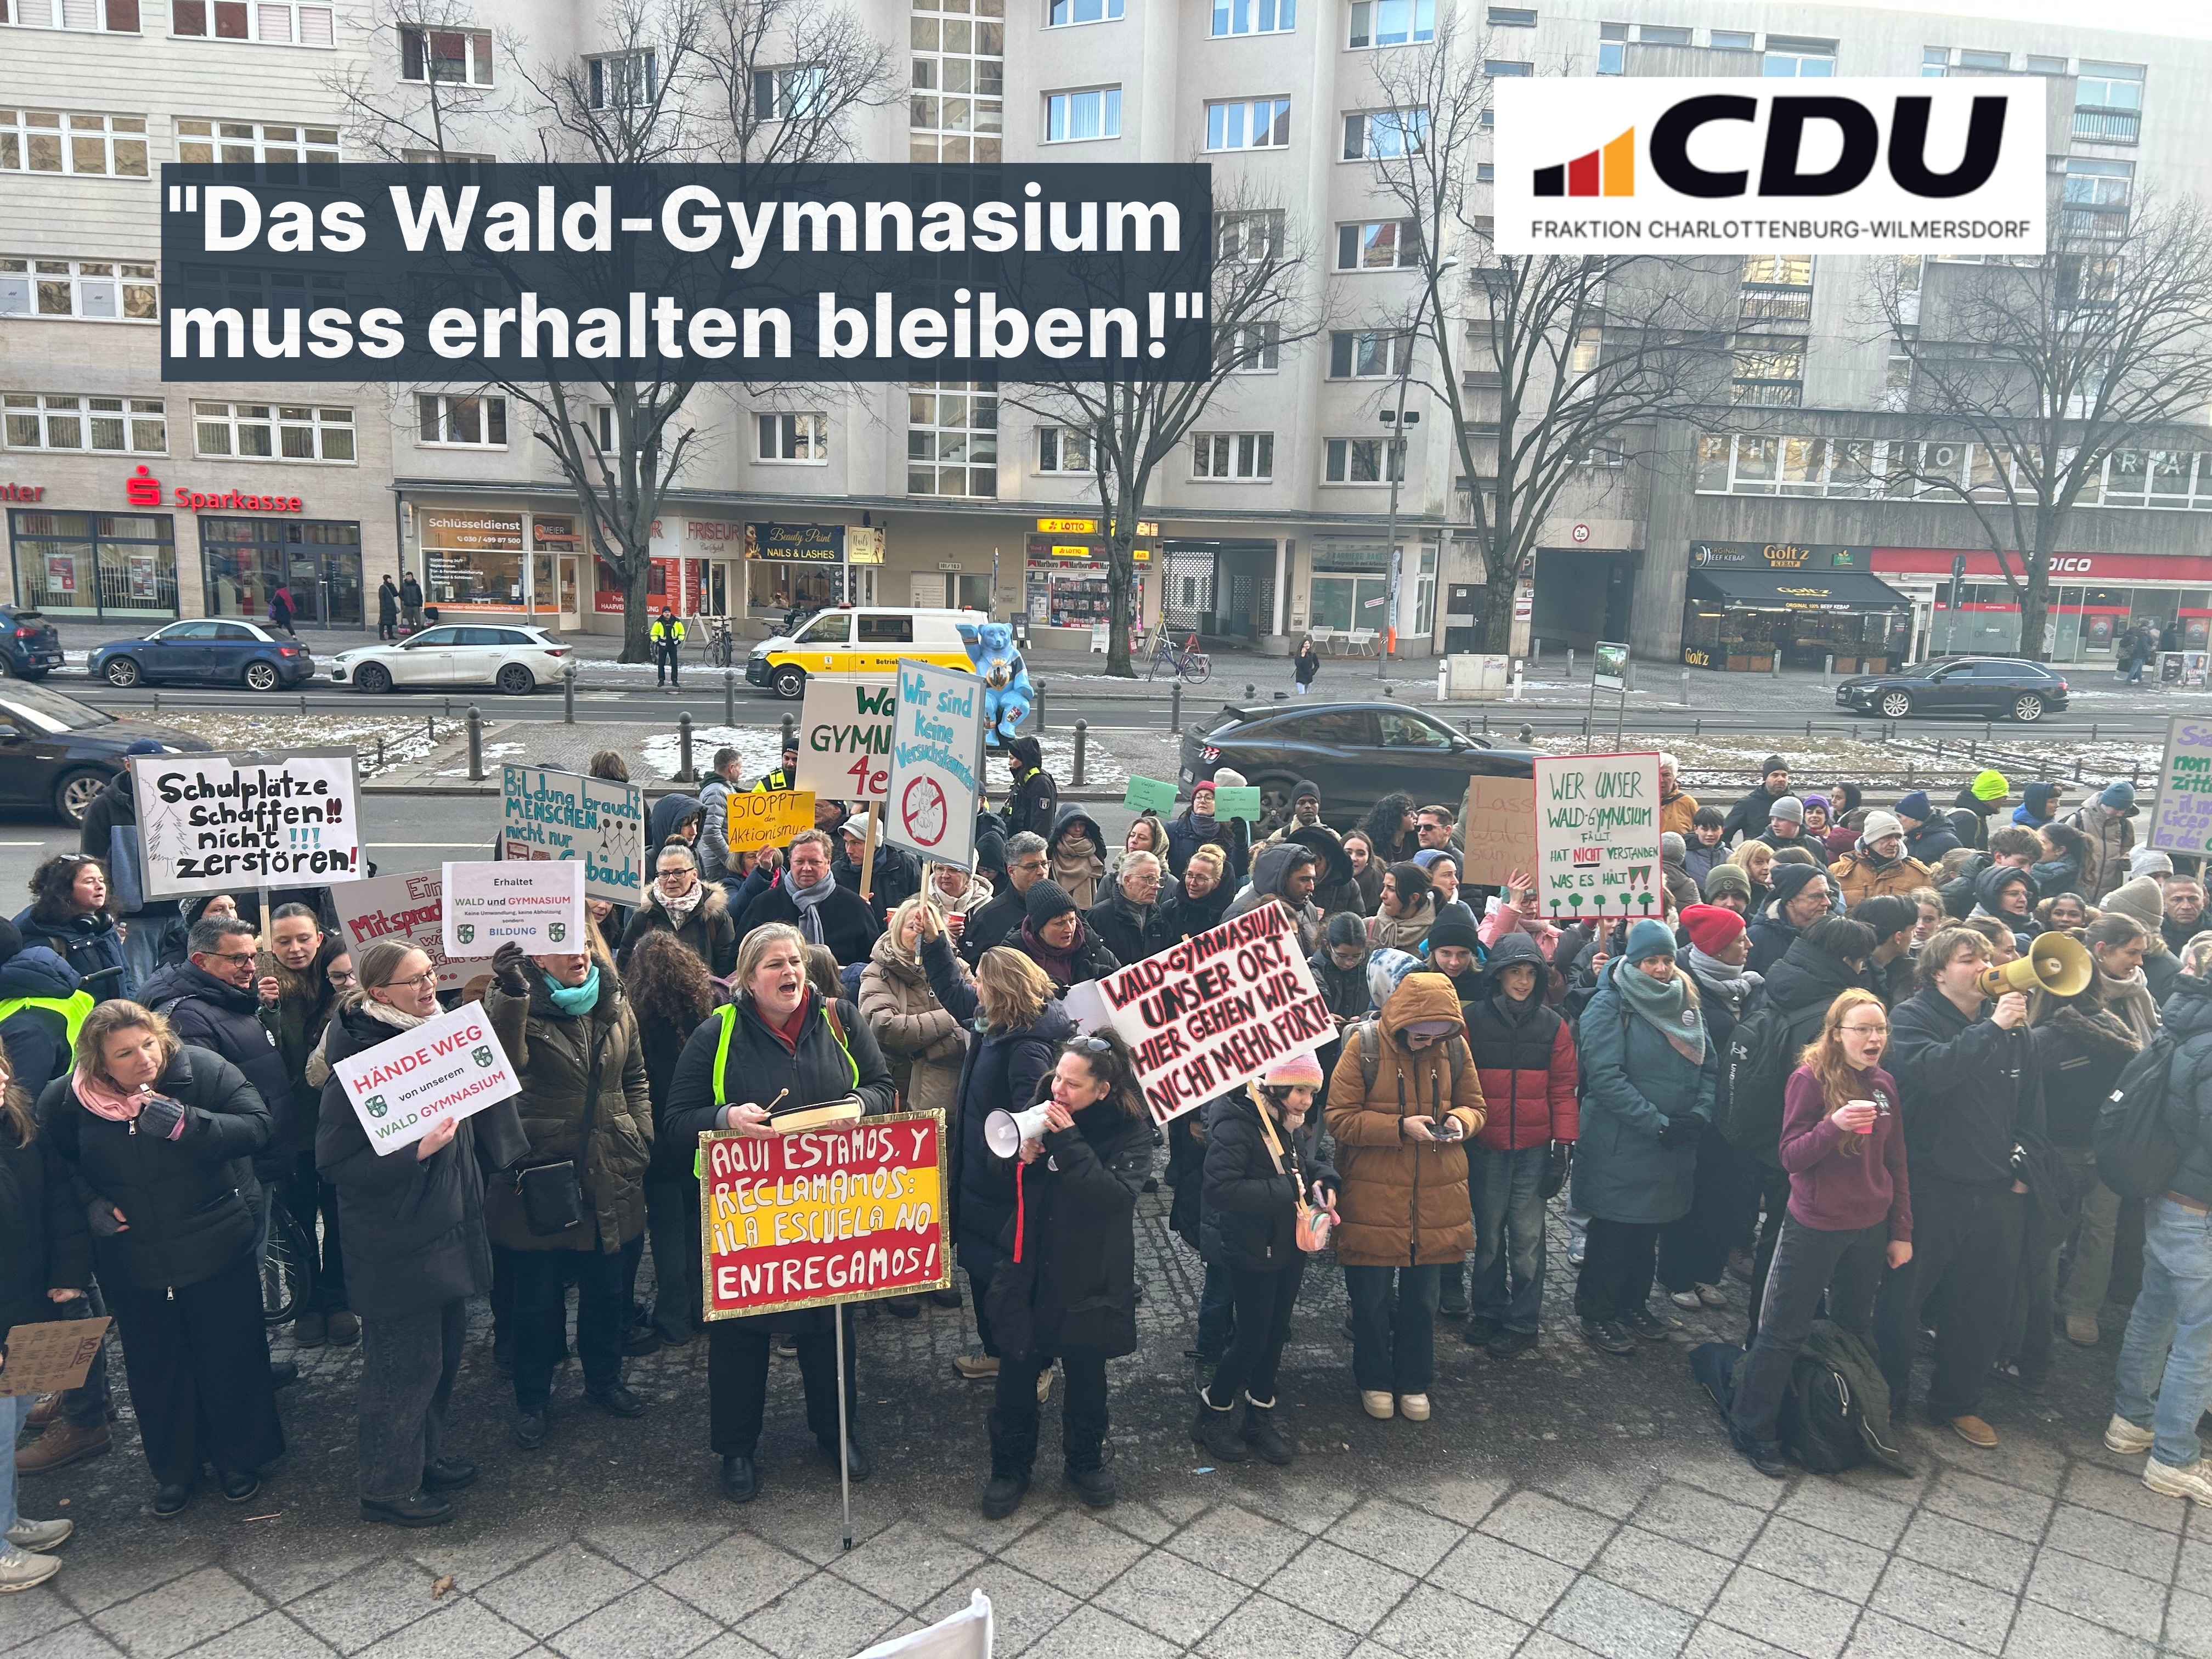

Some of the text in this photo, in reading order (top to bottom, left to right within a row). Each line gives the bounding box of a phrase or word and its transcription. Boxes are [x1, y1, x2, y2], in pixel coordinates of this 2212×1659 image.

[174, 488, 302, 511] Sparkasse
[428, 518, 521, 531] Schlüsseldienst
[687, 521, 741, 541] FRISEUR
[770, 527, 832, 546] Beauty Point
[1060, 522, 1085, 531] LOTTO
[767, 548, 835, 560] NAILS & LASHES
[1036, 560, 1059, 568] Marlboro
[902, 672, 974, 719] Wir sind
[810, 724, 892, 755] GYMN
[2172, 755, 2211, 772] non
[157, 769, 328, 810] Schulplätze
[504, 767, 642, 820] Bildung braucht
[1549, 770, 1644, 801] WER UNSER
[733, 792, 804, 819] STOPPT
[764, 814, 776, 822] den
[1547, 805, 1652, 833] WALD-GYMNASIUM
[198, 823, 280, 850] nicht
[505, 819, 573, 849] nicht nur
[176, 847, 358, 879] zerstören!
[1550, 848, 1570, 862] HAT
[1573, 847, 1605, 864] NICHT
[1606, 845, 1659, 860] VERSTANDEN
[494, 878, 533, 886] Erhaltet
[1550, 873, 1574, 889] WAS
[1579, 874, 1595, 887] ES
[455, 896, 571, 906] WALD und GYMNASIUM
[489, 927, 537, 936] BILDUNG
[1101, 902, 1291, 1012] WALD-GYMNASIUM
[1138, 934, 1291, 1029] UNSER ORT,
[1130, 969, 1308, 1079] HIER GEHEN WIR
[352, 1025, 483, 1094] HÄNDE WEG
[1145, 993, 1332, 1122] NICHT MEHR FORT!
[398, 1066, 465, 1102] von unserem
[375, 1070, 506, 1140] WALD GYMNASIUM
[711, 1140, 769, 1178] AQUI
[910, 1126, 930, 1162] Y
[774, 1205, 884, 1247] ESCUELA
[894, 1201, 933, 1235] NO
[716, 1242, 937, 1300] ENTREGAMOS!
